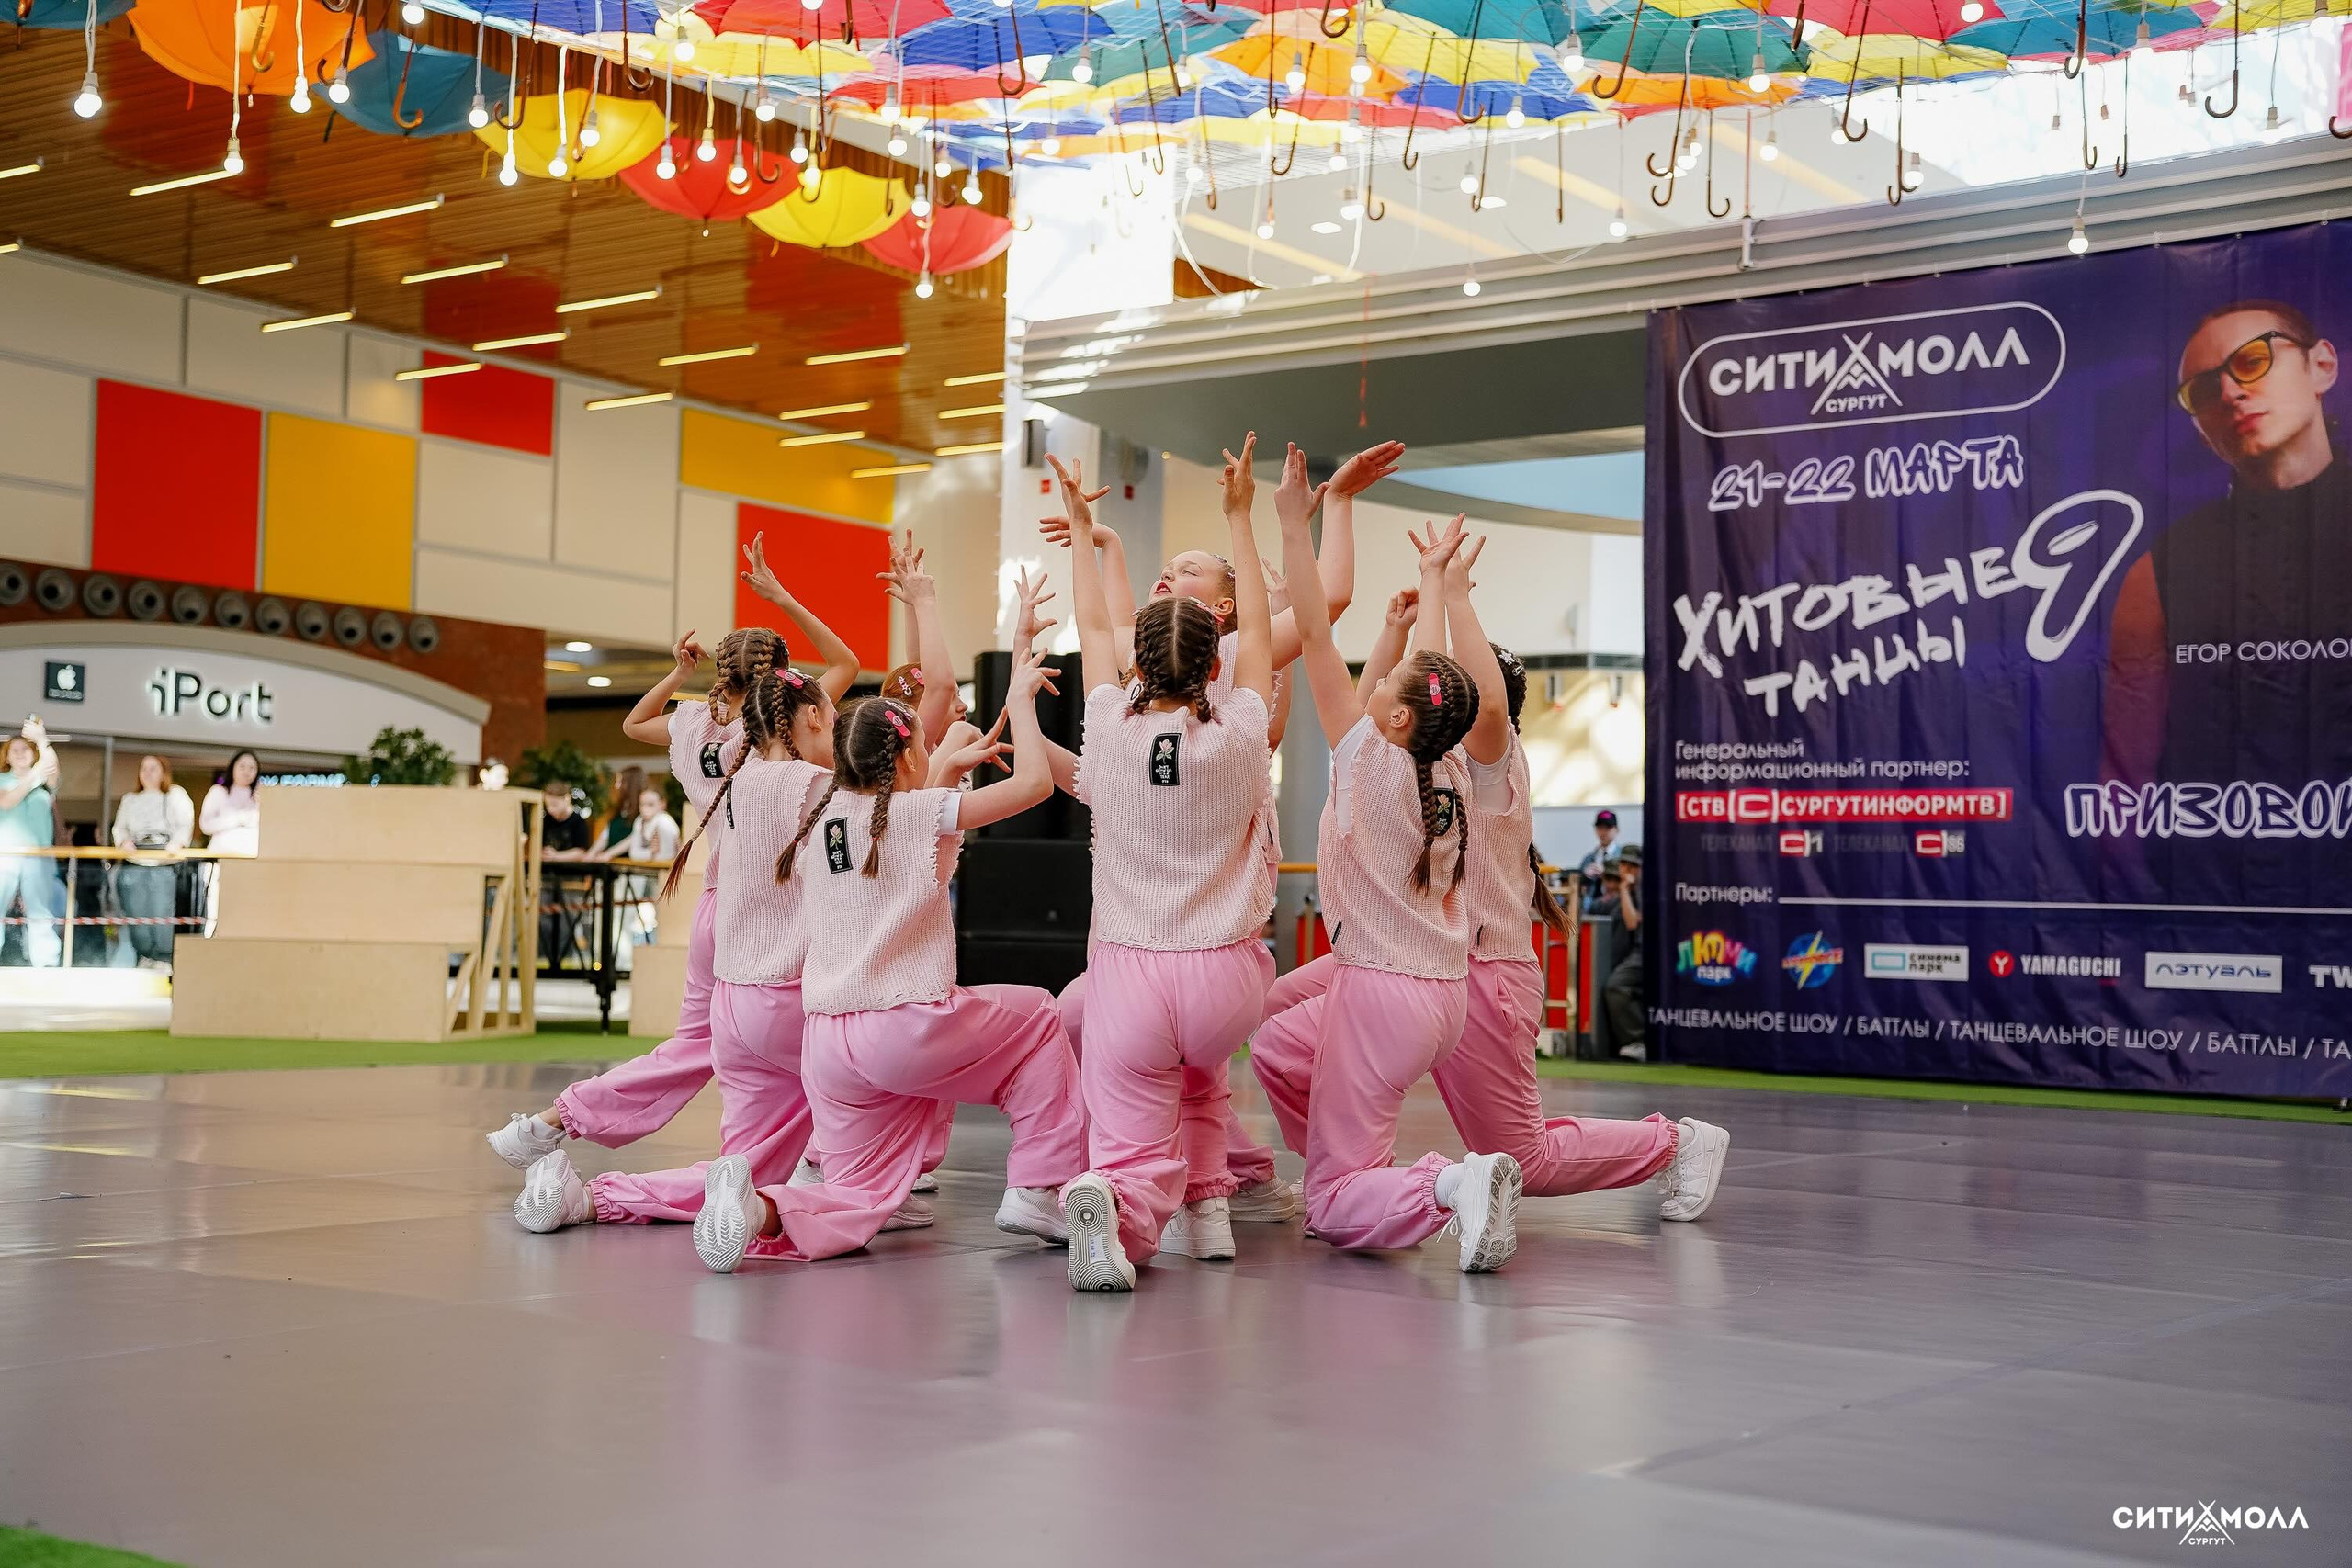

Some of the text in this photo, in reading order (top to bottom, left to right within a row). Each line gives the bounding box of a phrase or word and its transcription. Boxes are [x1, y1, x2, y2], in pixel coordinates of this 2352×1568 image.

[1708, 326, 2030, 396] СИТИ МОЛЛ
[1825, 393, 1888, 413] СУРГУТ
[1707, 435, 2024, 512] 21-22 МАРТА
[1672, 546, 2018, 678] ХИТОВЫЕ
[1743, 615, 1967, 717] ТАНЦЫ
[2175, 637, 2352, 663] ЕГОР СОКОЛО
[145, 666, 273, 726] iPort
[1674, 737, 1805, 762] Генеральный
[1674, 757, 1970, 783] информационный партнер:
[1675, 882, 1773, 906] Партнеры:
[2020, 954, 2122, 977] YAMAGUCHI
[1790, 1012, 1838, 1035] ШОУ
[1857, 1016, 1929, 1039] БАТТЛЫ
[1951, 1020, 2120, 1047] ТАНЦЕВАЛЬНОЕ
[2124, 1028, 2183, 1052] ШОУ
[2207, 1032, 2296, 1057] БАТТЛЫ
